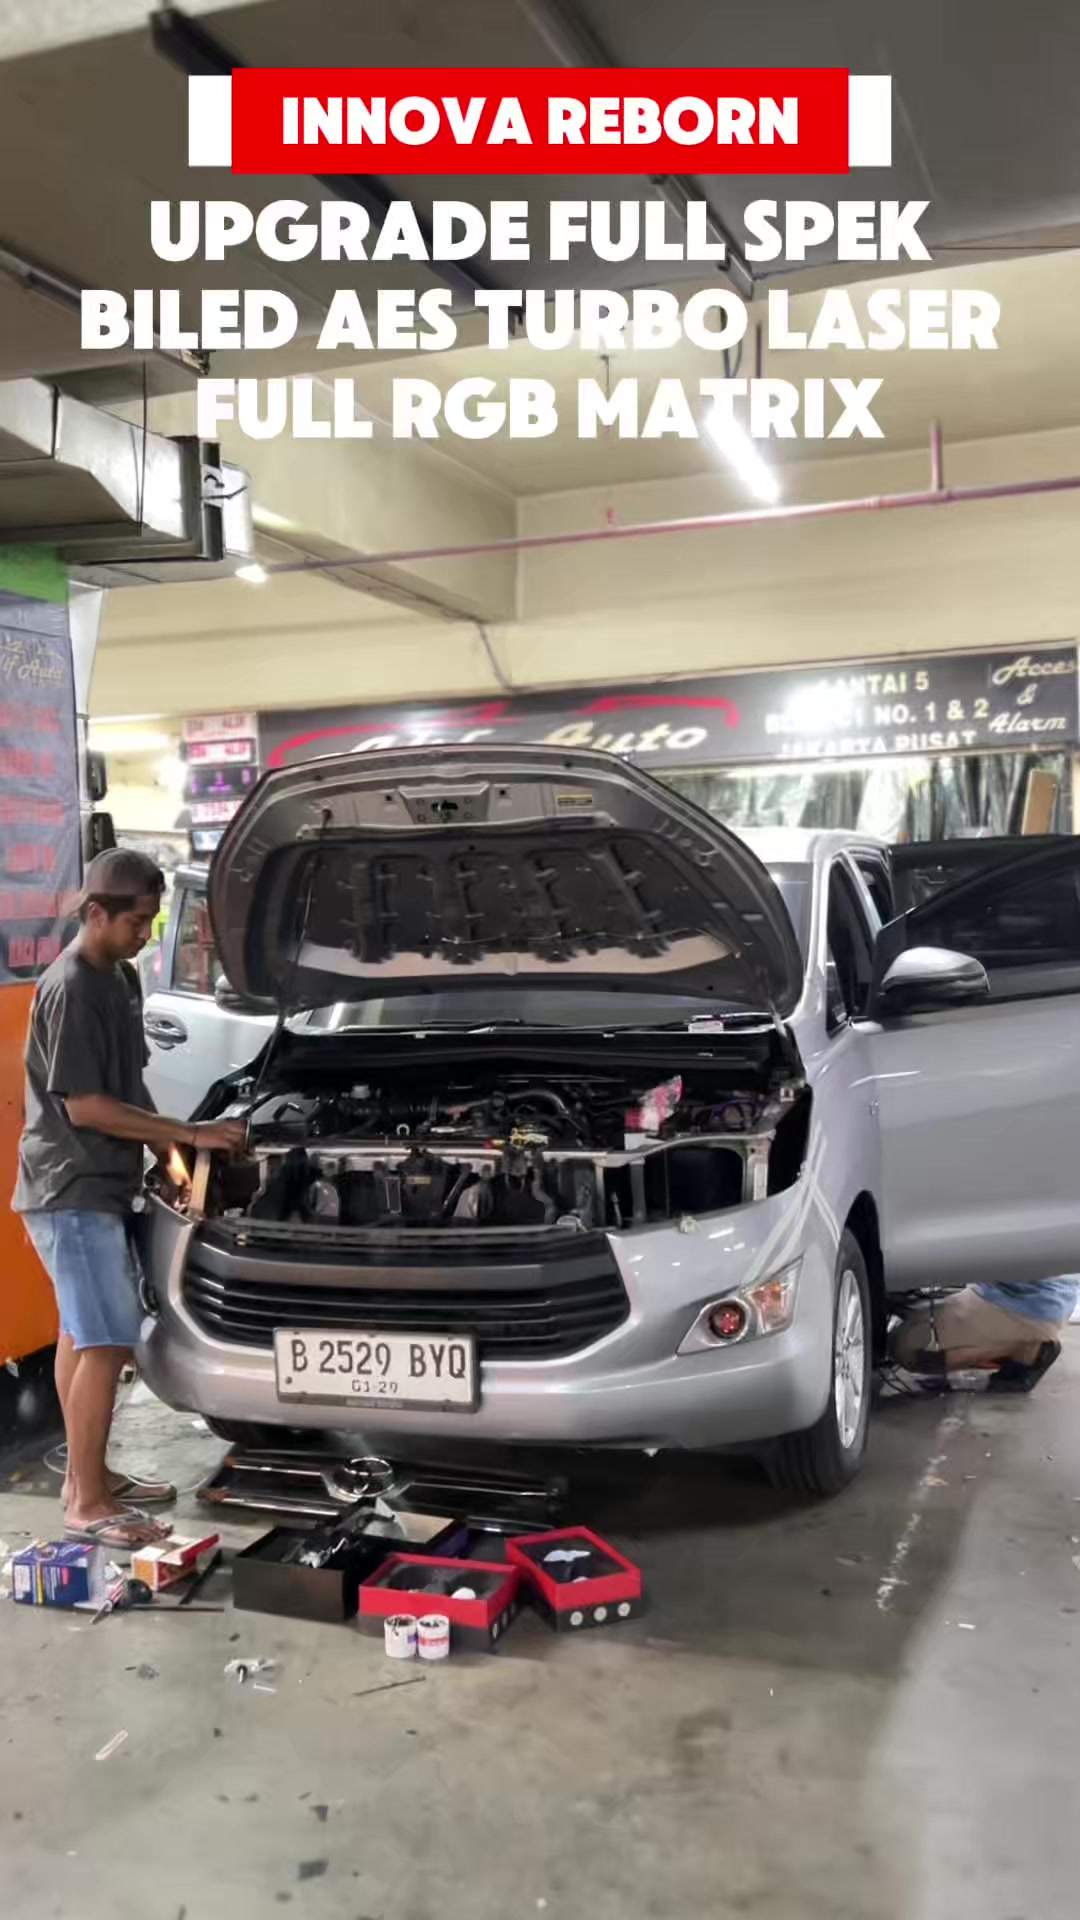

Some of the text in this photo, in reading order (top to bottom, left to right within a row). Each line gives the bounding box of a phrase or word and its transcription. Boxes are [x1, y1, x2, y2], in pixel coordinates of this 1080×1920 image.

[915, 671, 929, 691] 5
[874, 704, 917, 725] NO.
[926, 702, 936, 721] 1
[947, 699, 964, 720] &
[974, 698, 990, 719] 2
[988, 711, 1066, 734] Alarm
[543, 720, 708, 754] Auto
[291, 1339, 466, 1379] B 2529 BYQ
